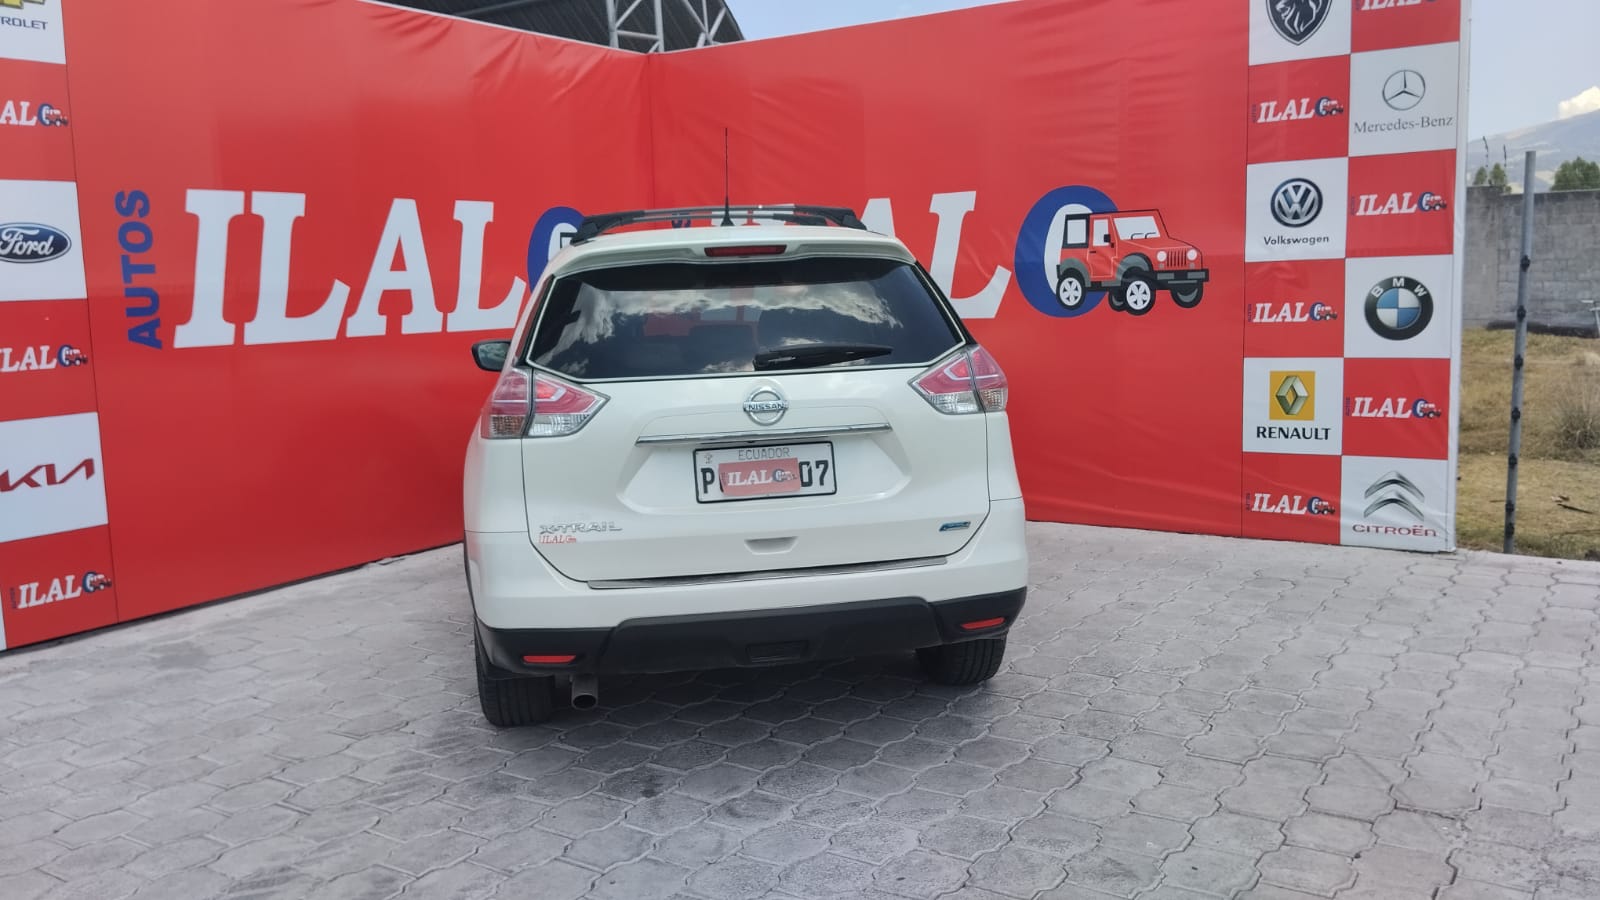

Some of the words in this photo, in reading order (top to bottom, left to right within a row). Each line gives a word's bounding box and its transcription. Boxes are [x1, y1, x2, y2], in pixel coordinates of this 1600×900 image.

[0, 16, 48, 30] ROLET
[1354, 116, 1453, 134] Mercedes-Benz
[0, 227, 54, 255] Ford
[1263, 235, 1330, 246] Volkswagen
[114, 190, 162, 350] AUTOS
[748, 402, 785, 411] NISSAN
[1256, 426, 1331, 441] RENAULT
[738, 447, 790, 461] ECUADOR
